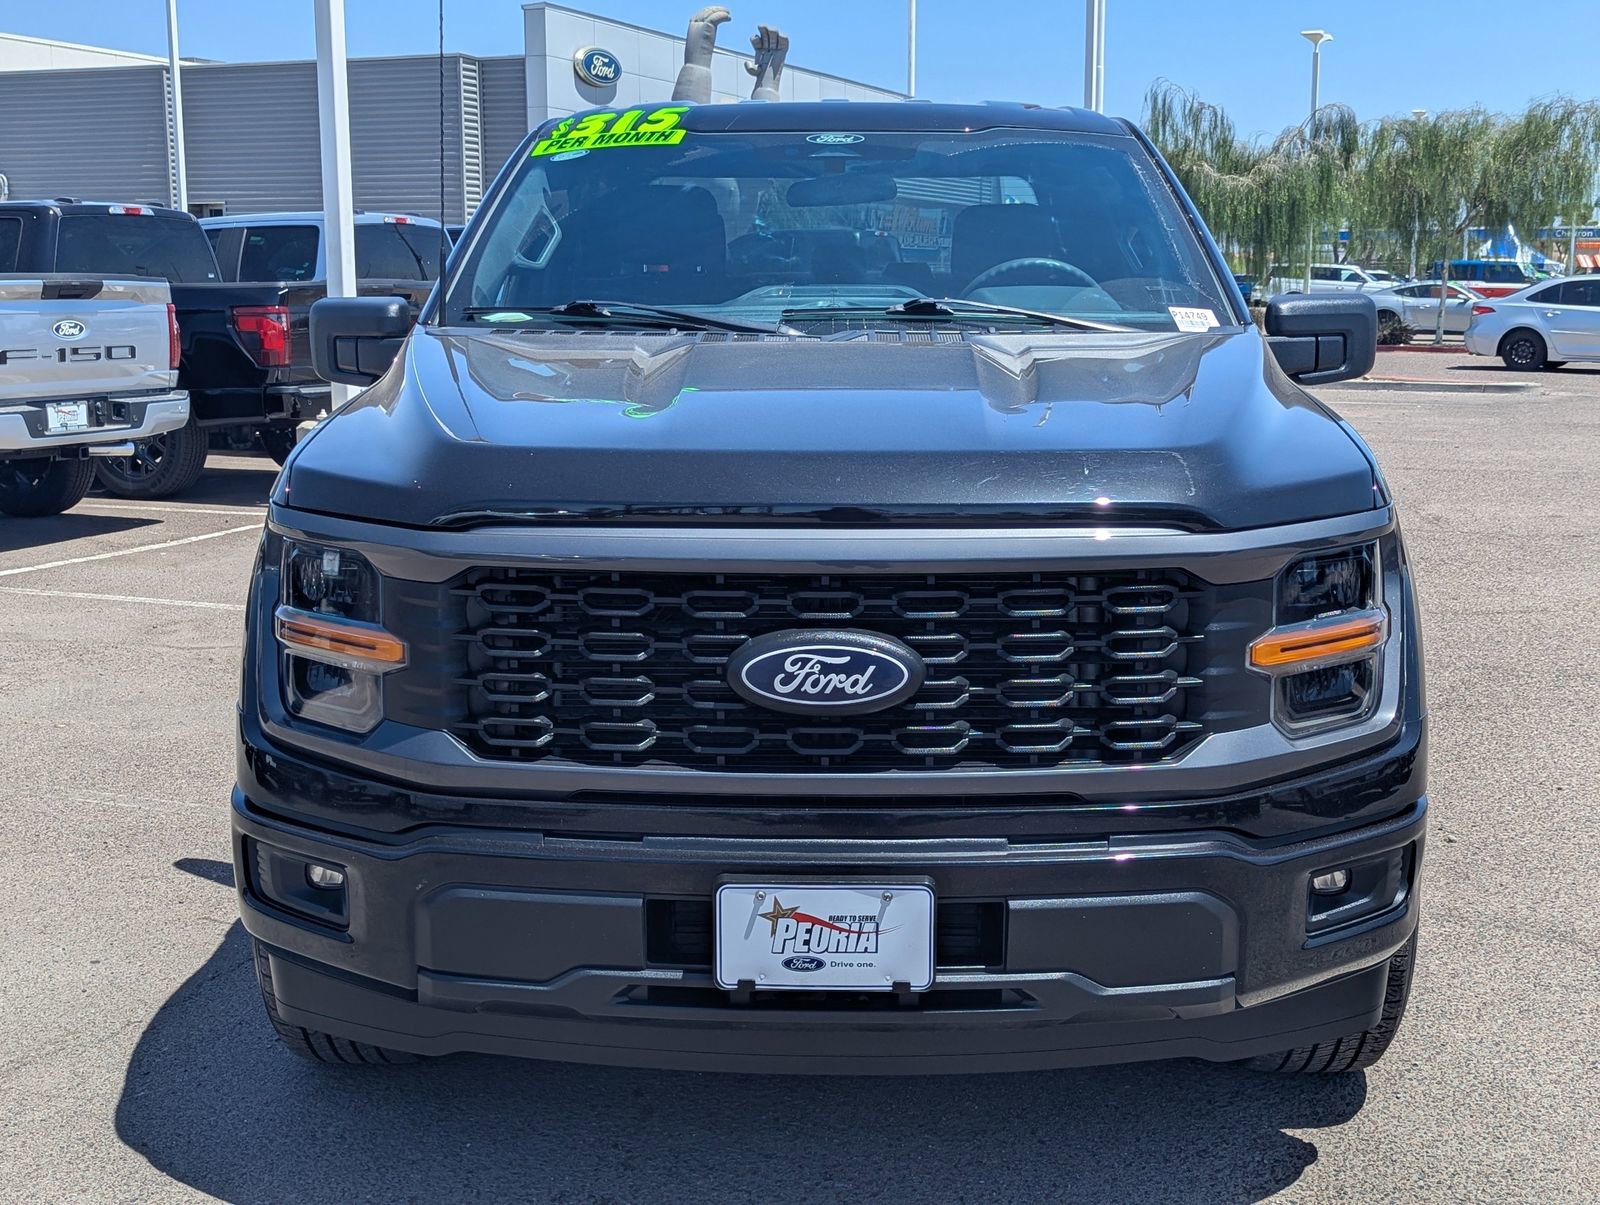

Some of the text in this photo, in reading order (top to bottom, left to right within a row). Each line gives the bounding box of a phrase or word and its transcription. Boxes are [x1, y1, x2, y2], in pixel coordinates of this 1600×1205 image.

[590, 55, 616, 79] Ford
[551, 106, 690, 139] $315
[543, 129, 673, 152] PER MONTH
[816, 134, 855, 142] Ford
[1555, 229, 1593, 238] Chron
[58, 322, 81, 336] Ford
[0, 345, 137, 365] F-150
[773, 653, 877, 695] Ford
[771, 917, 879, 954] PEORIA
[790, 958, 817, 969] Ford
[830, 960, 854, 968] Drive
